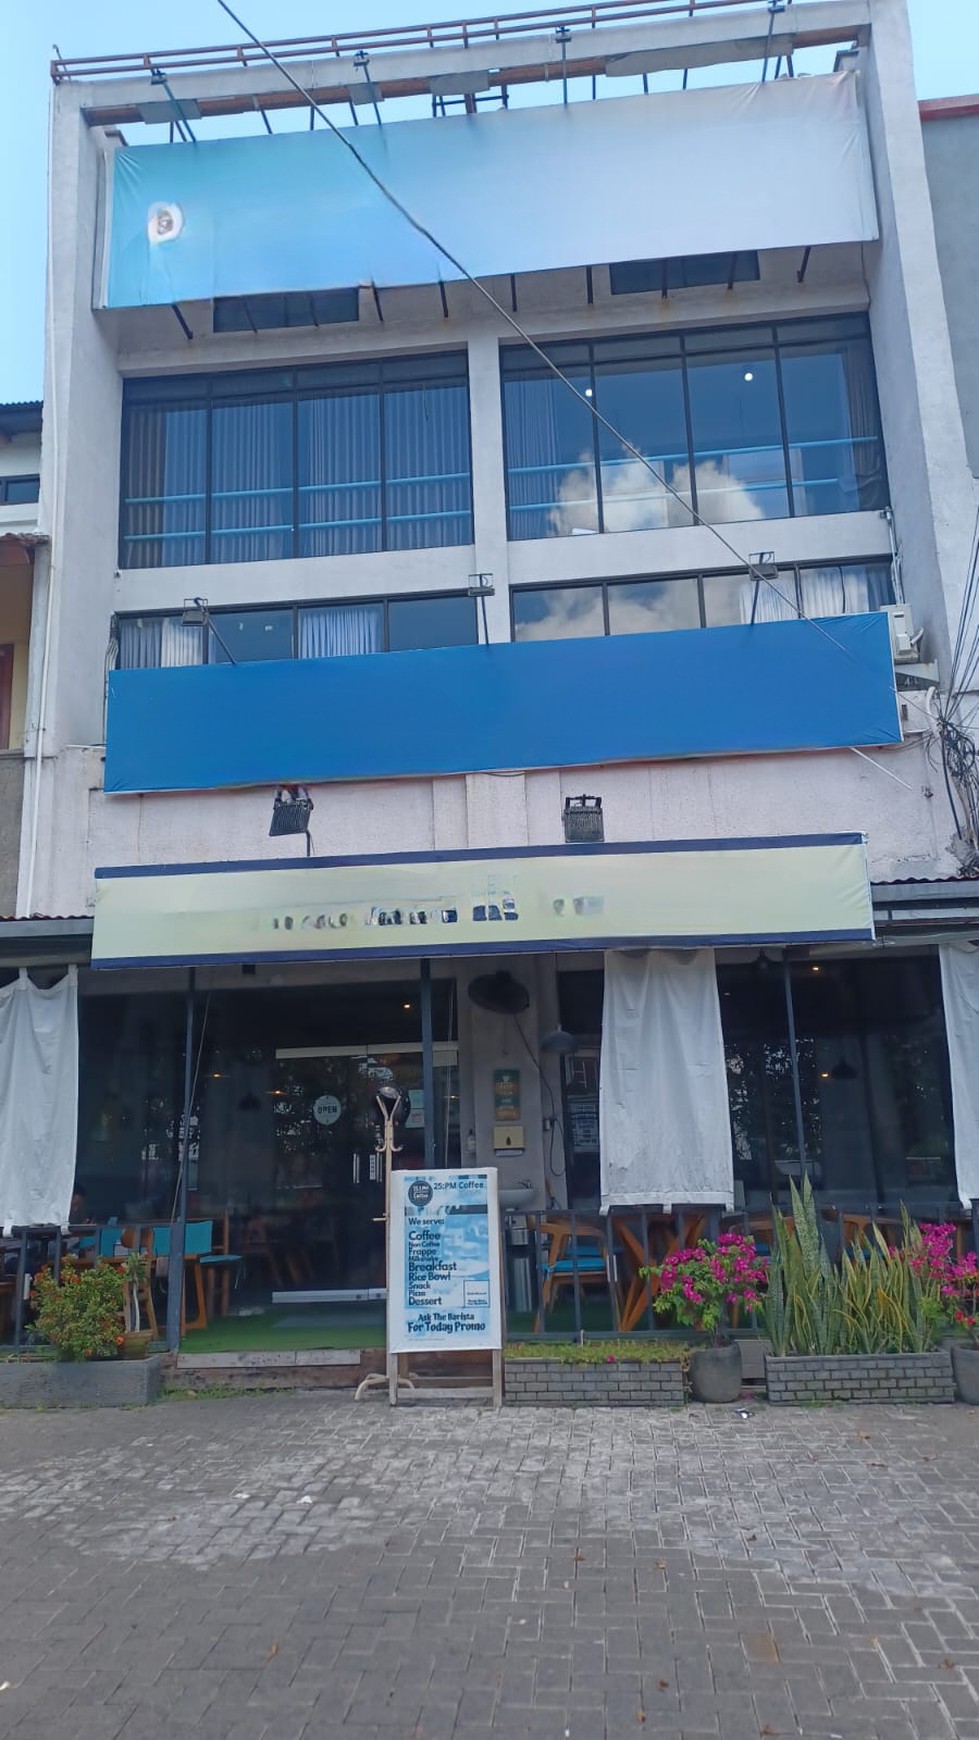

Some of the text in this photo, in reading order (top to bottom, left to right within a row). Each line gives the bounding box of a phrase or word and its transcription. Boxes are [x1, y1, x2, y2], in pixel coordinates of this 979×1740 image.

[317, 1106, 337, 1114] OPEN
[433, 1181, 484, 1190] 25:PM Coffee
[408, 1218, 421, 1226] We
[408, 1230, 441, 1241] Coffee
[408, 1247, 437, 1256] Frappe
[408, 1260, 457, 1272] Breakfast
[408, 1272, 451, 1281] Rice Bowl
[408, 1281, 431, 1290] Snack
[408, 1297, 442, 1306] Dessert
[418, 1312, 475, 1321] Ask The Barista
[408, 1321, 486, 1334] For Today Promo
